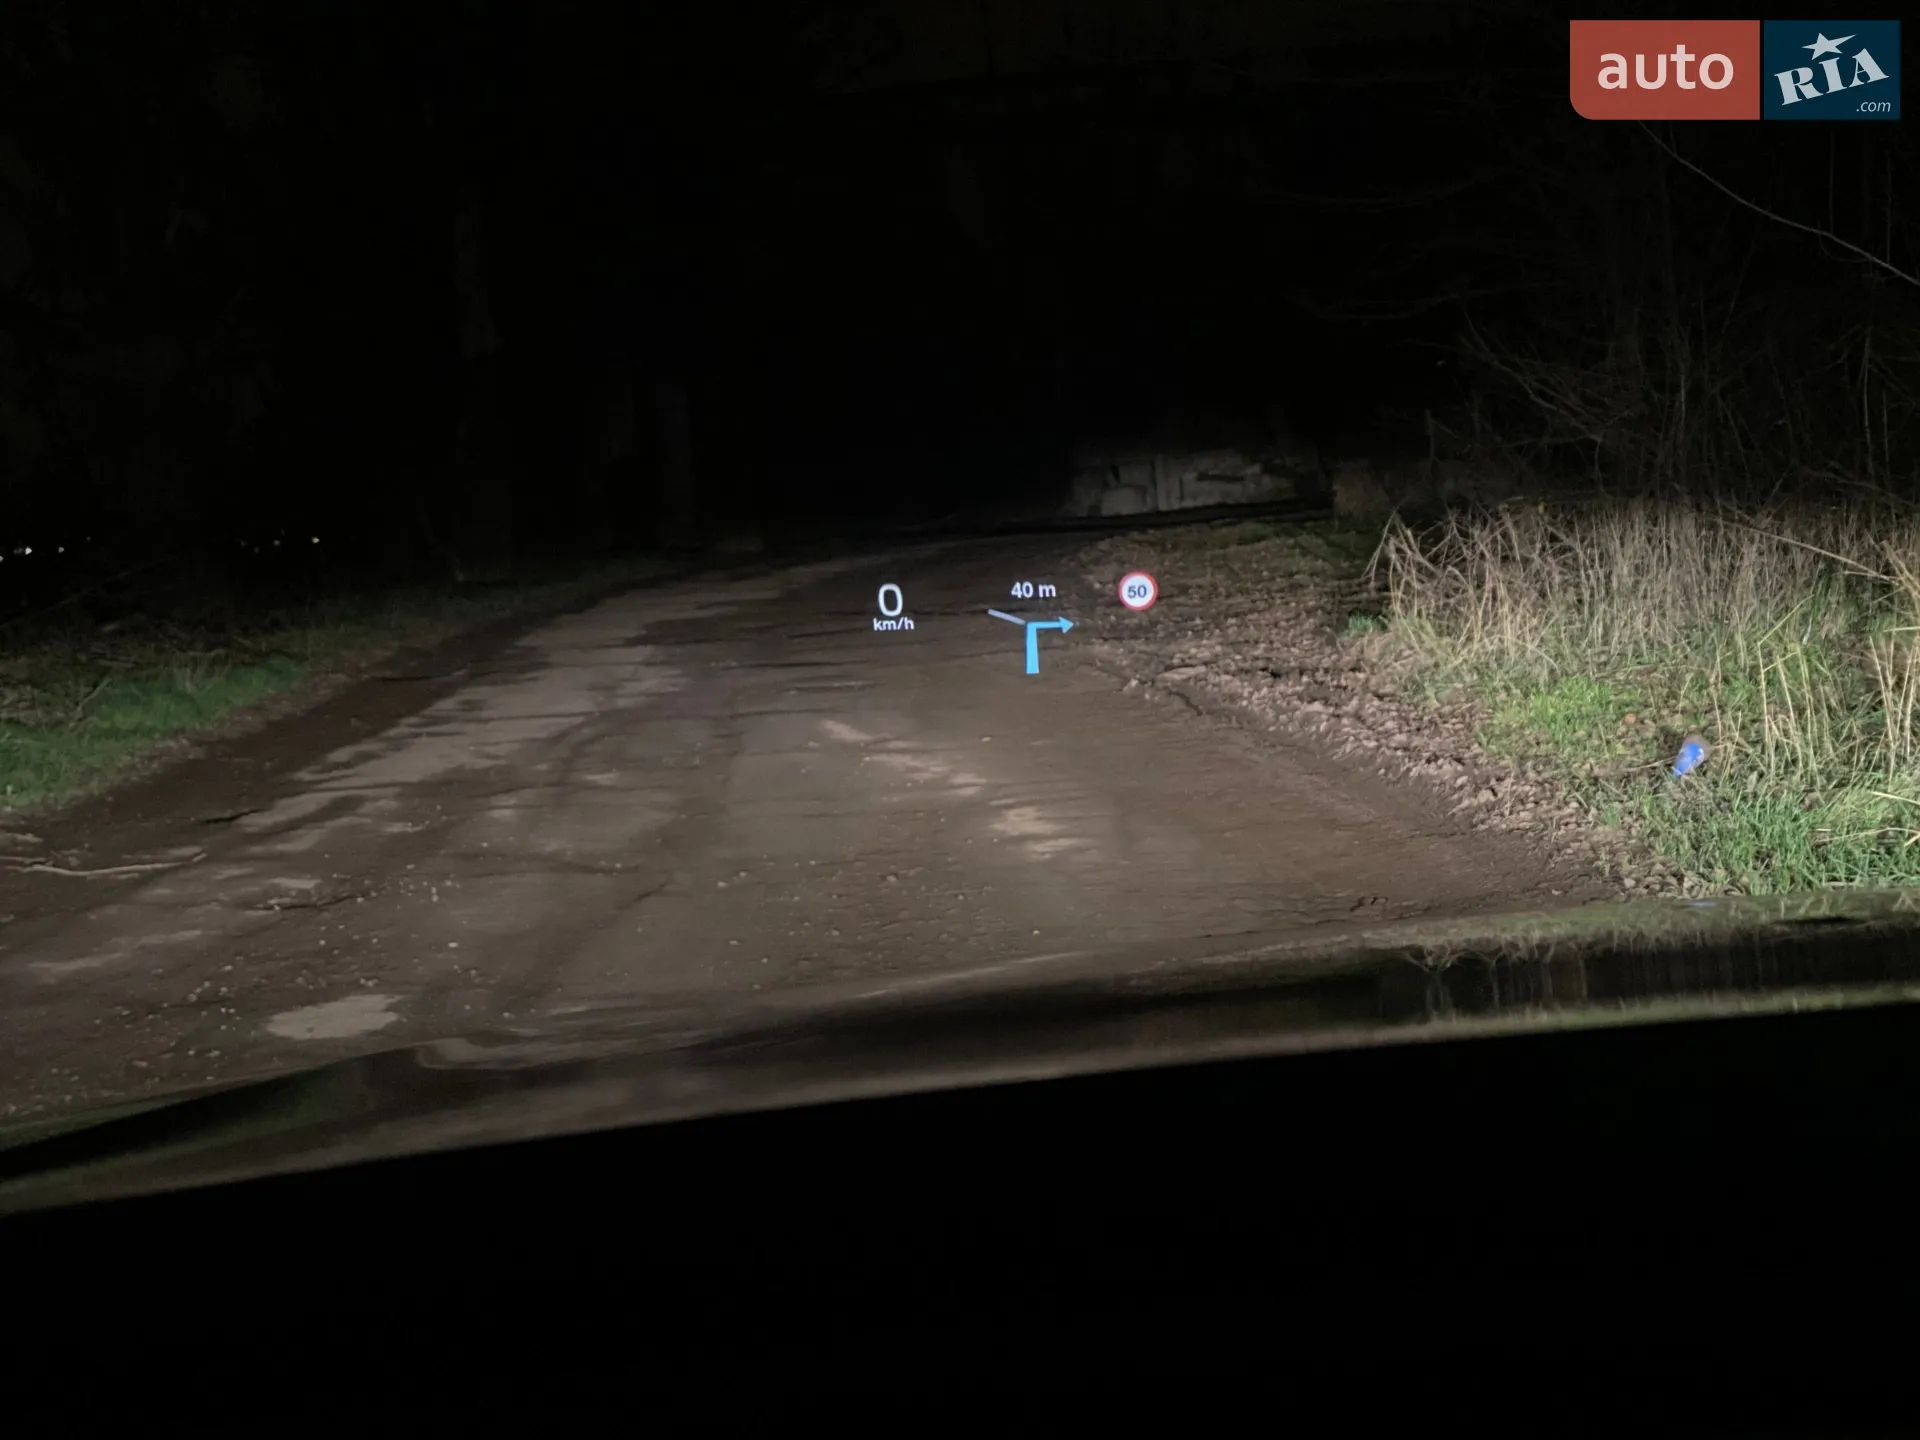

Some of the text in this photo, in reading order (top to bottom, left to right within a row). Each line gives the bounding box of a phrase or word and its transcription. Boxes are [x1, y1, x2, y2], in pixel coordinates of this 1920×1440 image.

[1010, 581, 1057, 598] 40 m
[1127, 583, 1148, 598] 50
[877, 583, 903, 617] 0
[873, 617, 914, 631] km/h
